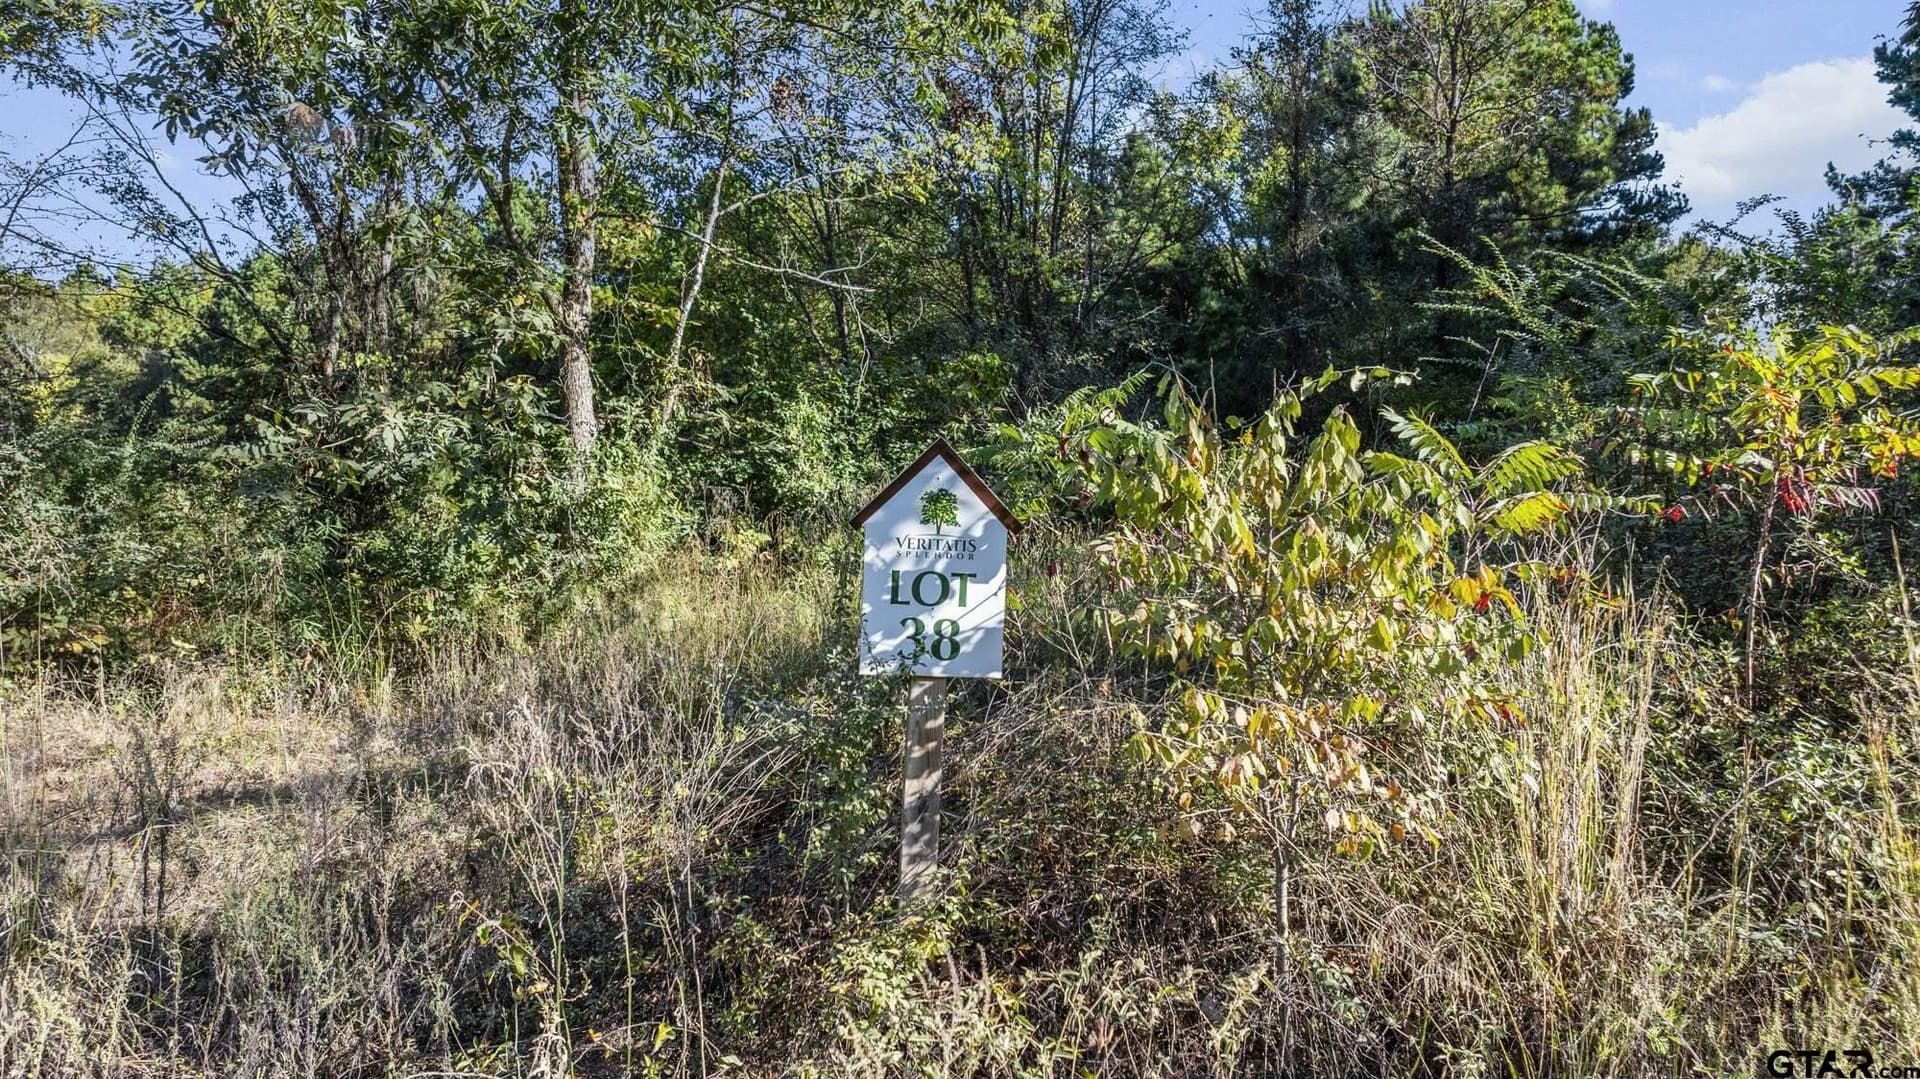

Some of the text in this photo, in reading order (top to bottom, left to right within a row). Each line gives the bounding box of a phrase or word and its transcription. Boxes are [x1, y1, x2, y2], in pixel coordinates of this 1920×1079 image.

[896, 535, 976, 552] VERITATIS
[896, 551, 975, 561] SPLENDOR
[890, 569, 977, 607] LOT
[900, 617, 961, 662] 38
